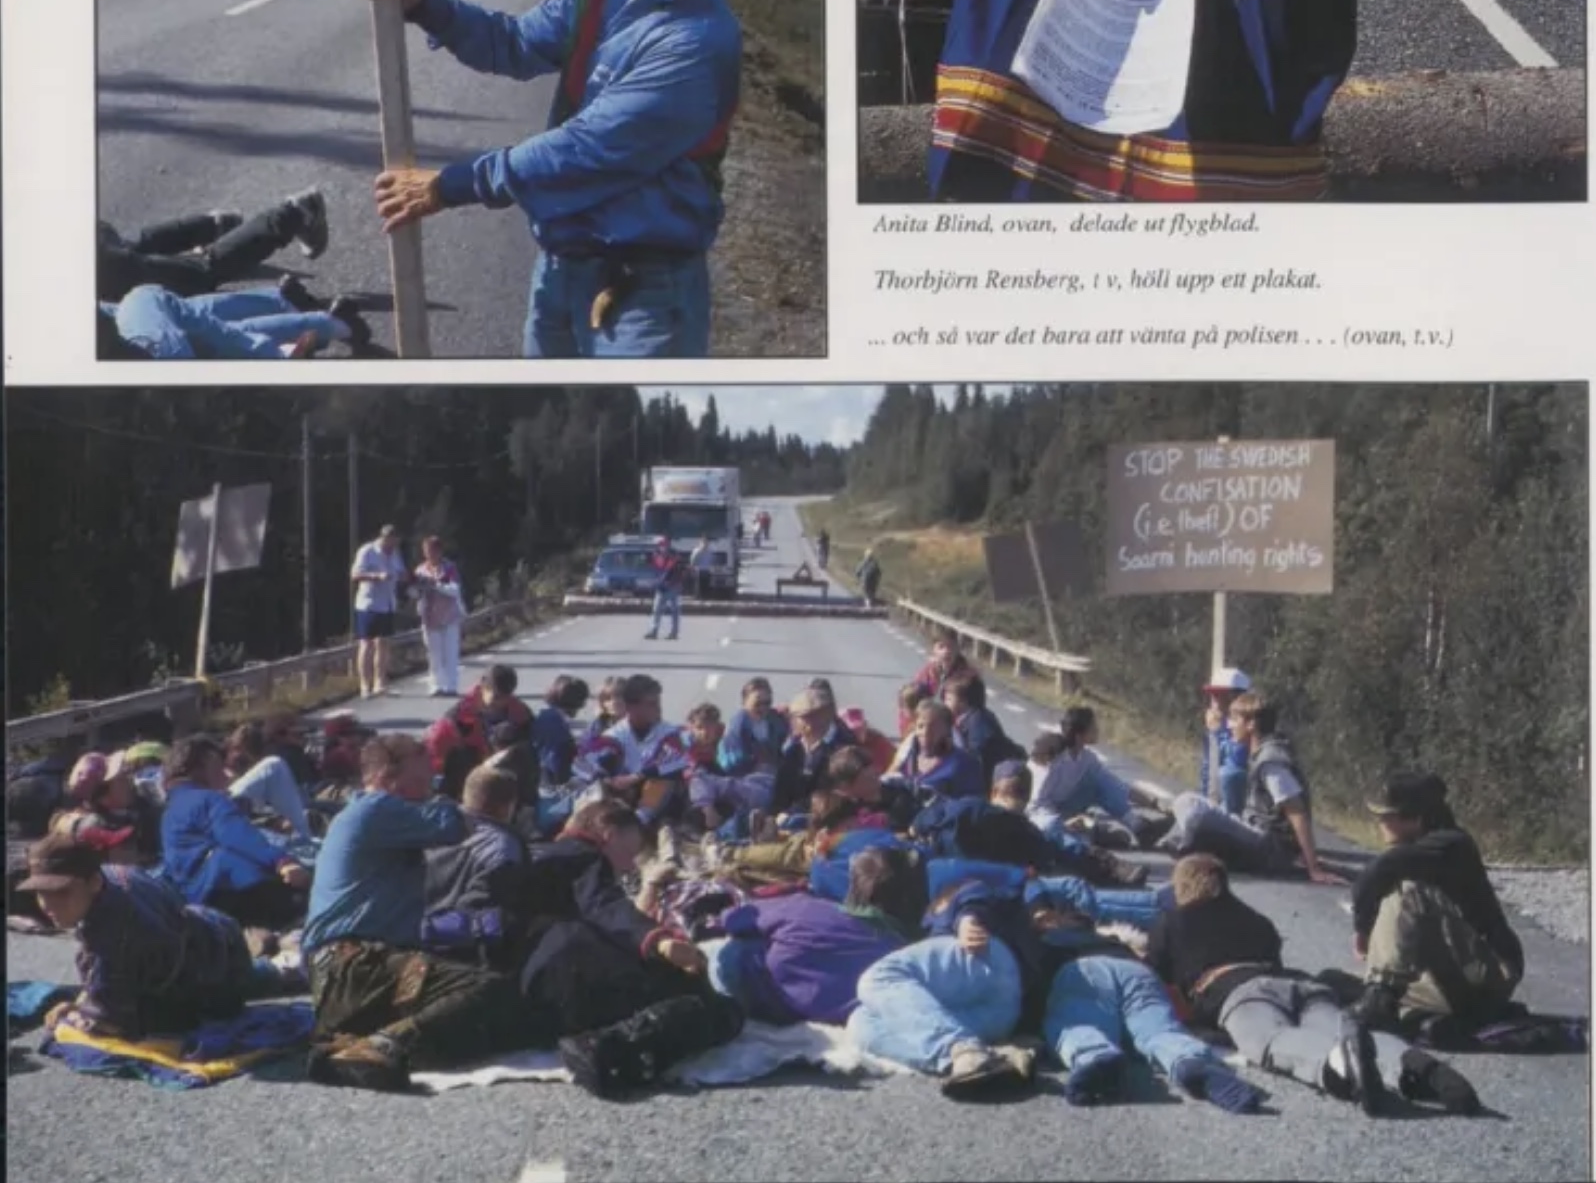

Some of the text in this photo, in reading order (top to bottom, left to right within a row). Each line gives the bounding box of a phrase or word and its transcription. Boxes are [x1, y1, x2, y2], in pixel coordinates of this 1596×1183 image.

[871, 212, 1260, 237] Anita Blind, ovan, delade ut flygblad.
[874, 269, 979, 294] Thorbjörn
[984, 268, 1086, 294] Rensberg,
[1106, 275, 1123, 292] v,
[1129, 268, 1171, 290] höll
[1174, 274, 1216, 294] upp
[1220, 273, 1248, 290] ett
[1249, 268, 1322, 295] plakat.
[891, 326, 930, 346] och
[934, 326, 960, 346] så
[965, 329, 1001, 346] var
[1003, 325, 1037, 346] det
[1041, 325, 1092, 346] bara
[1094, 327, 1125, 346] att
[1129, 326, 1187, 346] vänta
[1190, 324, 1220, 350] på
[1222, 325, 1299, 350] polisen
[1342, 325, 1407, 348] (ovan,
[1412, 327, 1455, 349] t.v.)
[1124, 444, 1312, 478] STOP THE SWEDISH
[1238, 503, 1274, 532] OF
[1184, 539, 1257, 576] hunting
[1262, 537, 1325, 574] rights
